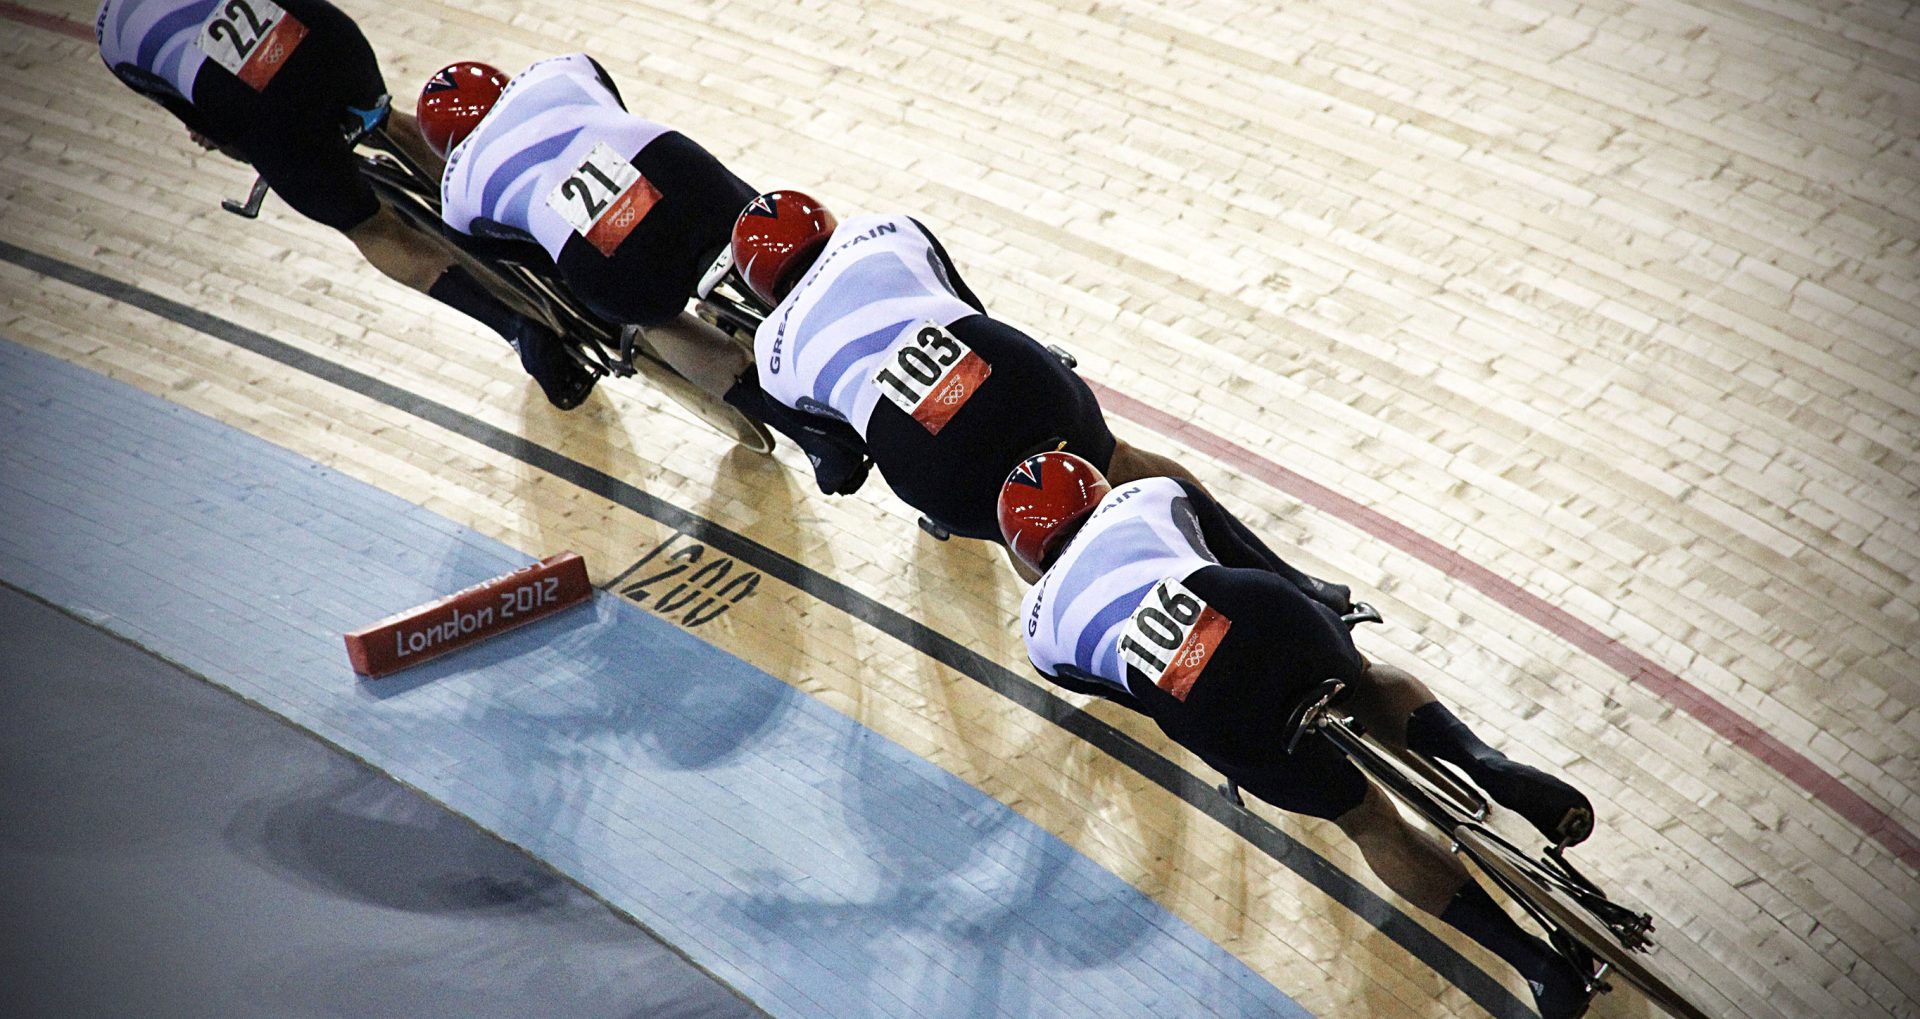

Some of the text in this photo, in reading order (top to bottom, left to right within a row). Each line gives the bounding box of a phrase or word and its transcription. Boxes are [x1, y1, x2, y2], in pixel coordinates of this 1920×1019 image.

[208, 0, 272, 61] 22
[561, 161, 621, 221] 21
[876, 327, 962, 404] 103
[396, 607, 493, 658] London
[500, 576, 560, 618] 2012
[620, 544, 761, 628] 200
[1120, 583, 1202, 673] 106
